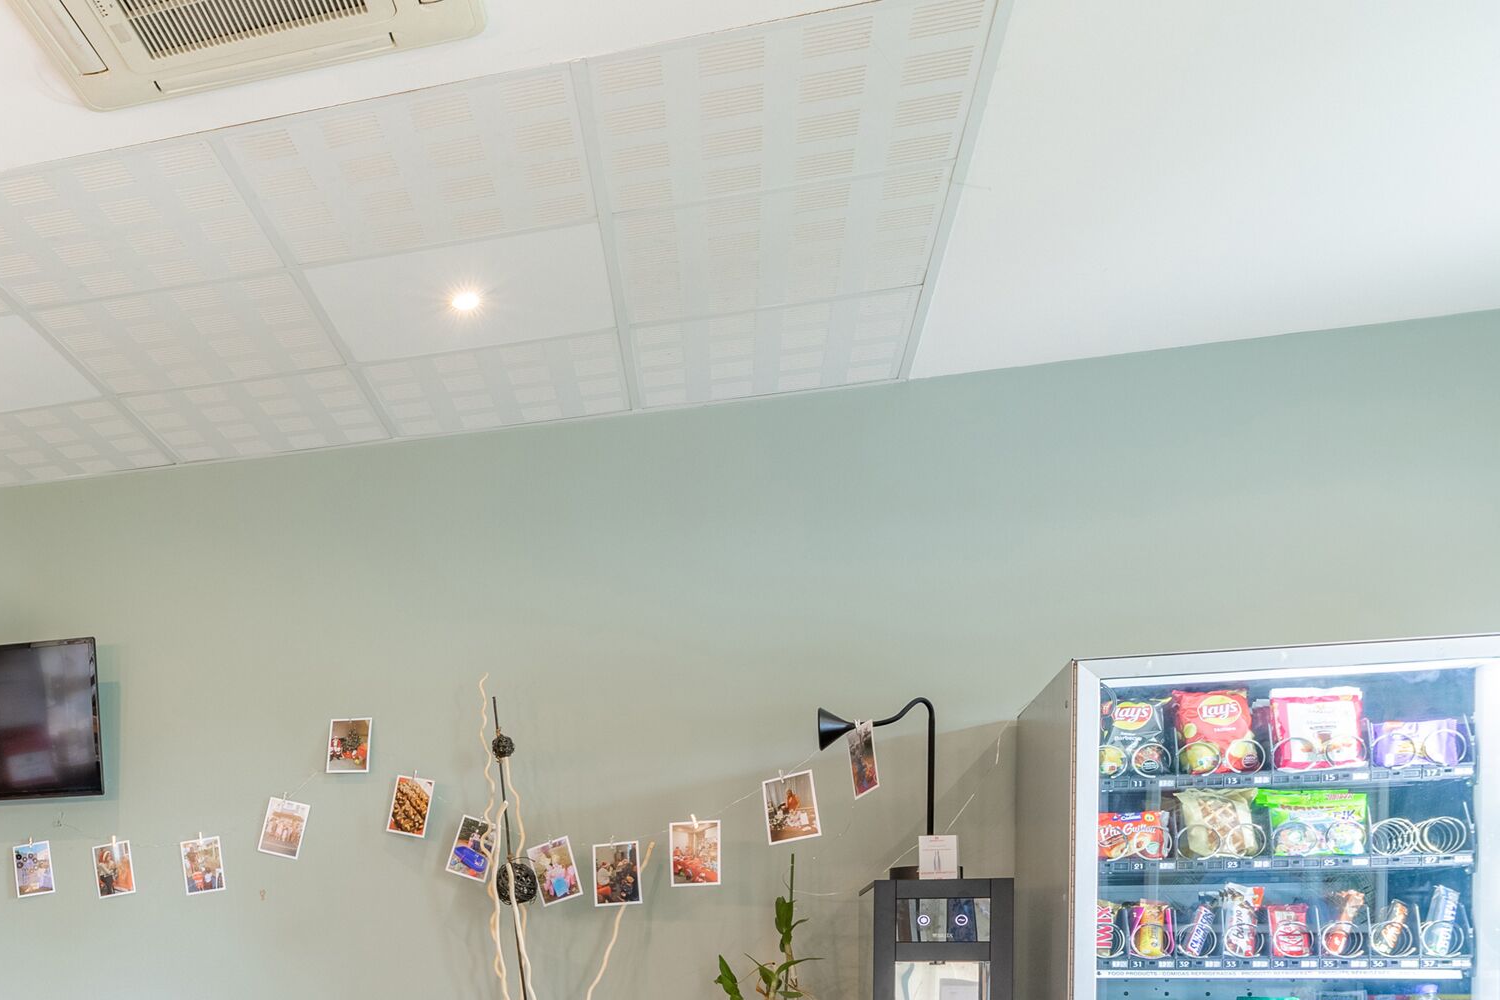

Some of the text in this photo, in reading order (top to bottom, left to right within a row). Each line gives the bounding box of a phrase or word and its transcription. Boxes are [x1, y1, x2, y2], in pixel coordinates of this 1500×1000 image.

[1273, 960, 1285, 968] 34
[1323, 960, 1335, 968] 35
[1372, 960, 1384, 968] 36
